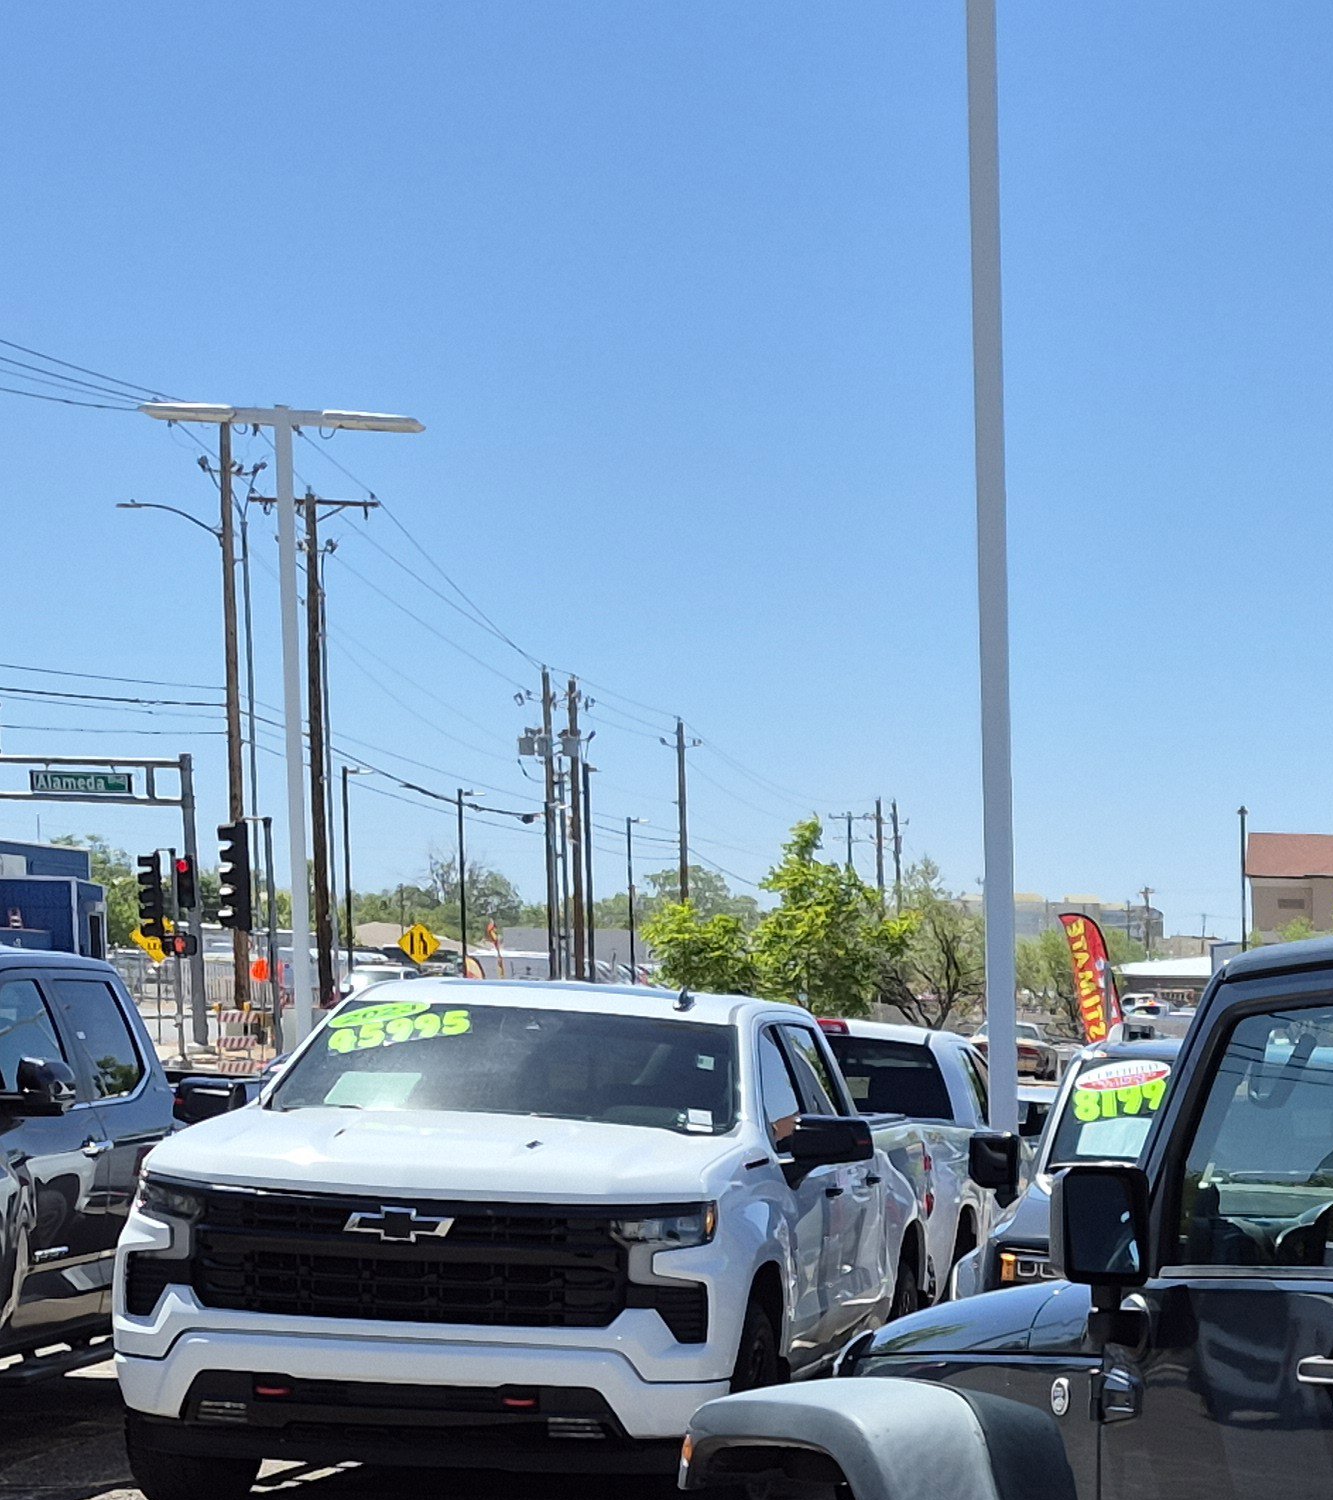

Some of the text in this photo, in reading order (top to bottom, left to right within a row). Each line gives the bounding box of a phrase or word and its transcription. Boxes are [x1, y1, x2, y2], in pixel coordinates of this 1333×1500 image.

[35, 774, 106, 791] Alameda
[327, 1010, 471, 1054] 45995
[1074, 1079, 1167, 1122] 8199
